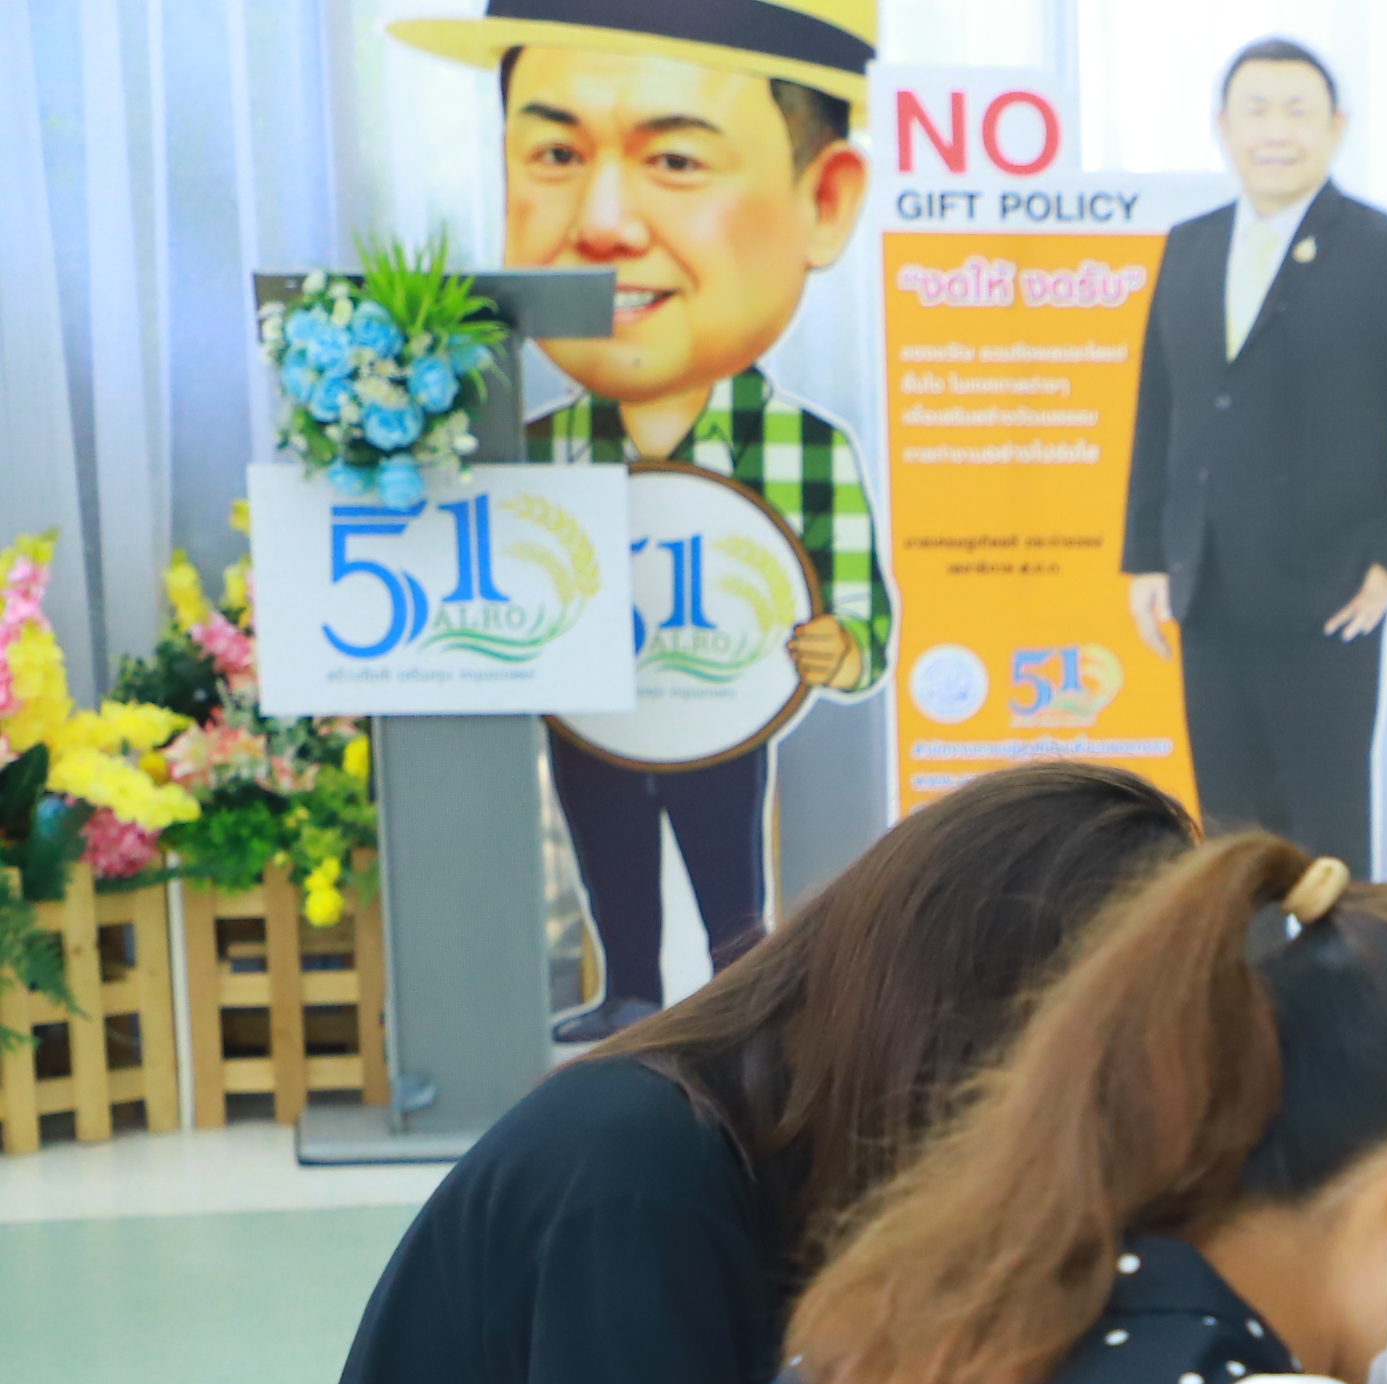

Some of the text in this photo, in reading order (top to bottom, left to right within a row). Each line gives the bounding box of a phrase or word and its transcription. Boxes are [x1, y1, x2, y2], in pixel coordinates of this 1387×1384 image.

[896, 89, 1060, 177] NO
[896, 190, 1140, 222] GIFT POLICY
[321, 491, 510, 660] 51
[433, 603, 528, 631] ALRO
[1008, 645, 1083, 717] 51
